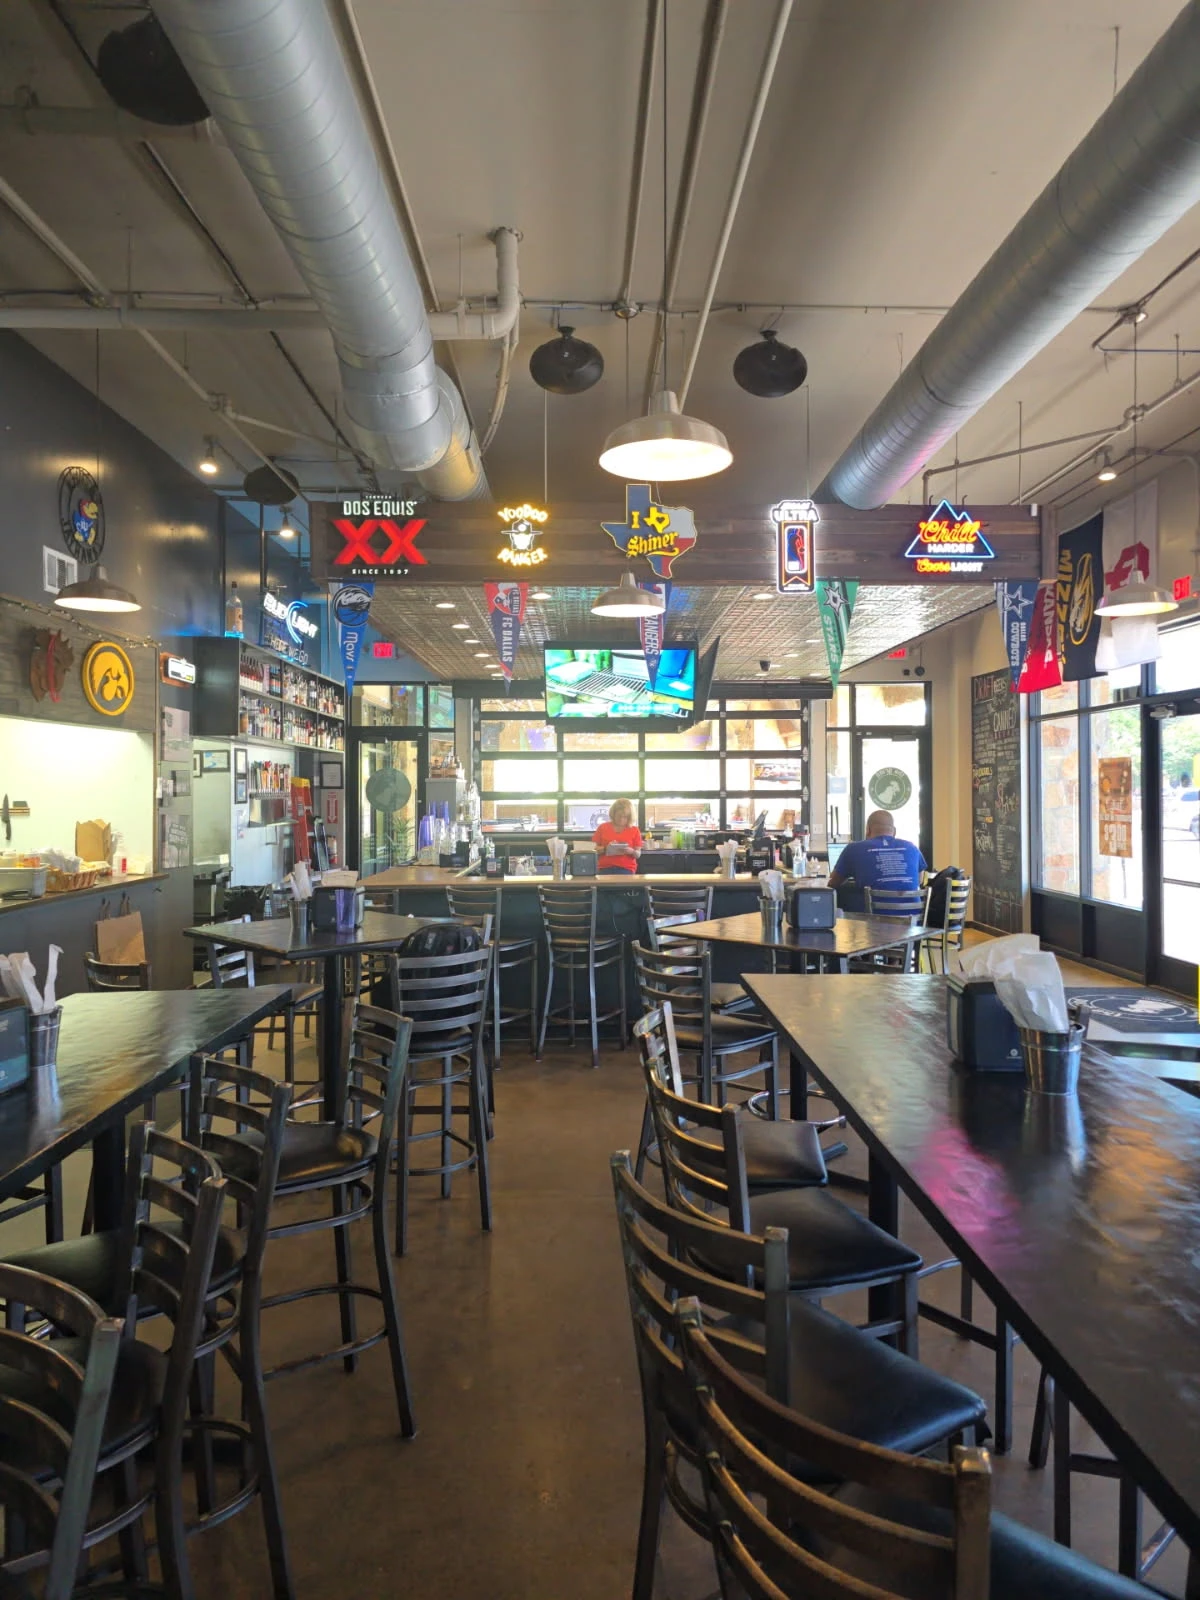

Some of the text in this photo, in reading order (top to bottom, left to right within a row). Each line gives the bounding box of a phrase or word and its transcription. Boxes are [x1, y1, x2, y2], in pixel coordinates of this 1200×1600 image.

[343, 500, 416, 518] DOS EQUIS
[497, 503, 549, 523] VOODOO
[631, 510, 641, 529] I
[772, 508, 819, 523] ULTRA
[332, 518, 430, 565] XX
[918, 520, 982, 543] Chill
[626, 531, 680, 559] Shiner
[927, 543, 975, 554] HARDER
[496, 547, 549, 567] RANGER
[263, 592, 319, 638] BUD LIGHT
[502, 616, 513, 663] FC DALLAS
[823, 614, 840, 664] STARS
[1010, 621, 1020, 667] COWBOYS
